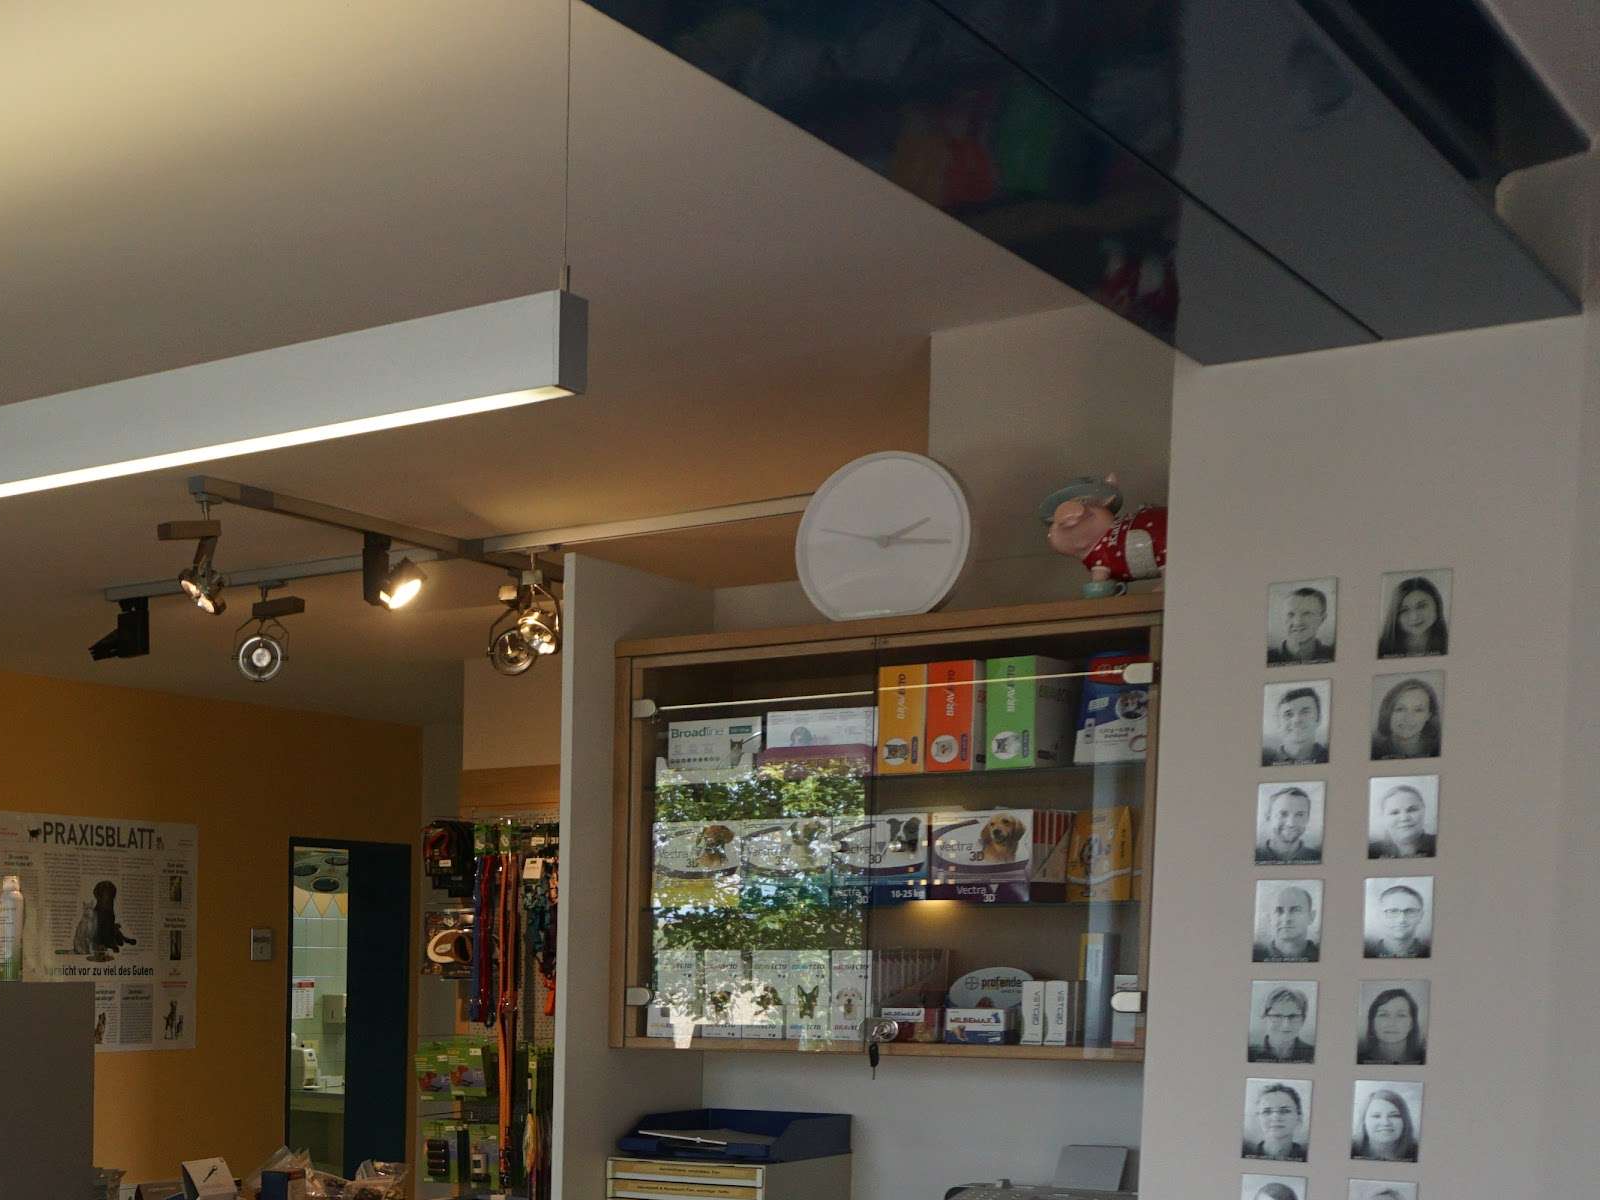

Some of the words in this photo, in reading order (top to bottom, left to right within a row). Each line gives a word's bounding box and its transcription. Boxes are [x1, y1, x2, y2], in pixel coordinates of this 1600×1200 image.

[896, 673, 906, 720] BRAVETO
[671, 726, 725, 738] Broadline
[42, 821, 155, 850] PRAXISBLATT
[970, 850, 984, 862] 3D
[956, 885, 987, 897] Vectra
[984, 893, 996, 904] 3D
[79, 967, 91, 977] vor
[93, 967, 102, 976] zu
[104, 965, 117, 976] viel
[119, 965, 131, 976] des
[133, 965, 154, 977] Guten
[981, 976, 1023, 990] profende
